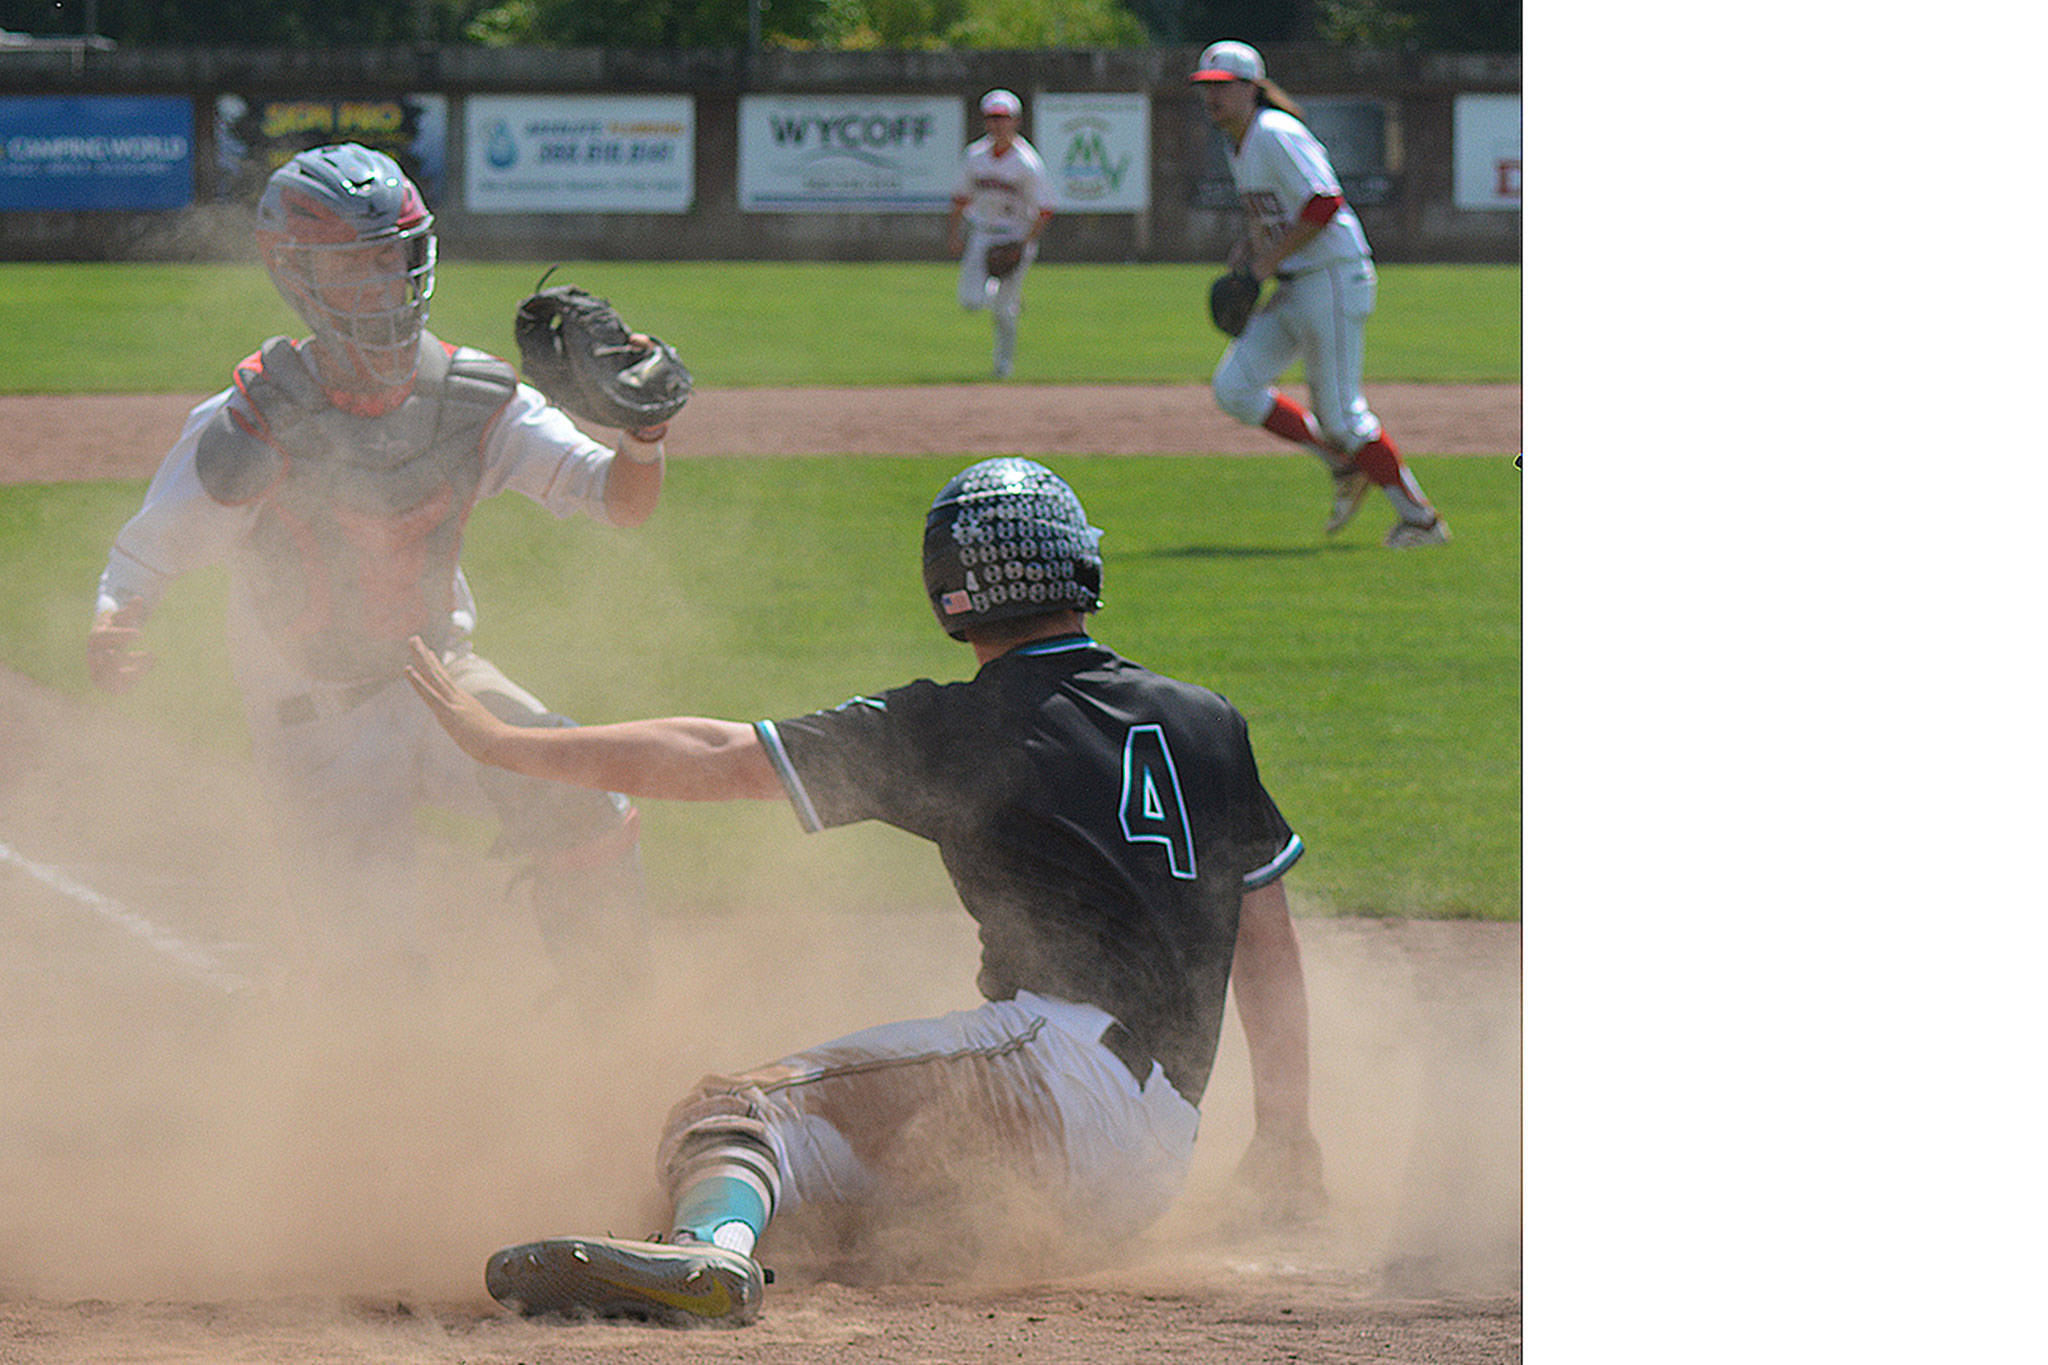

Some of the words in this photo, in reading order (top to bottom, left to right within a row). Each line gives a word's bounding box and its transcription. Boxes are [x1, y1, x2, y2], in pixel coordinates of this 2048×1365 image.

[7, 134, 109, 162] CAMPING
[111, 134, 188, 162] WORLD
[768, 114, 934, 148] WYCOFF
[1118, 724, 1198, 879] 4
